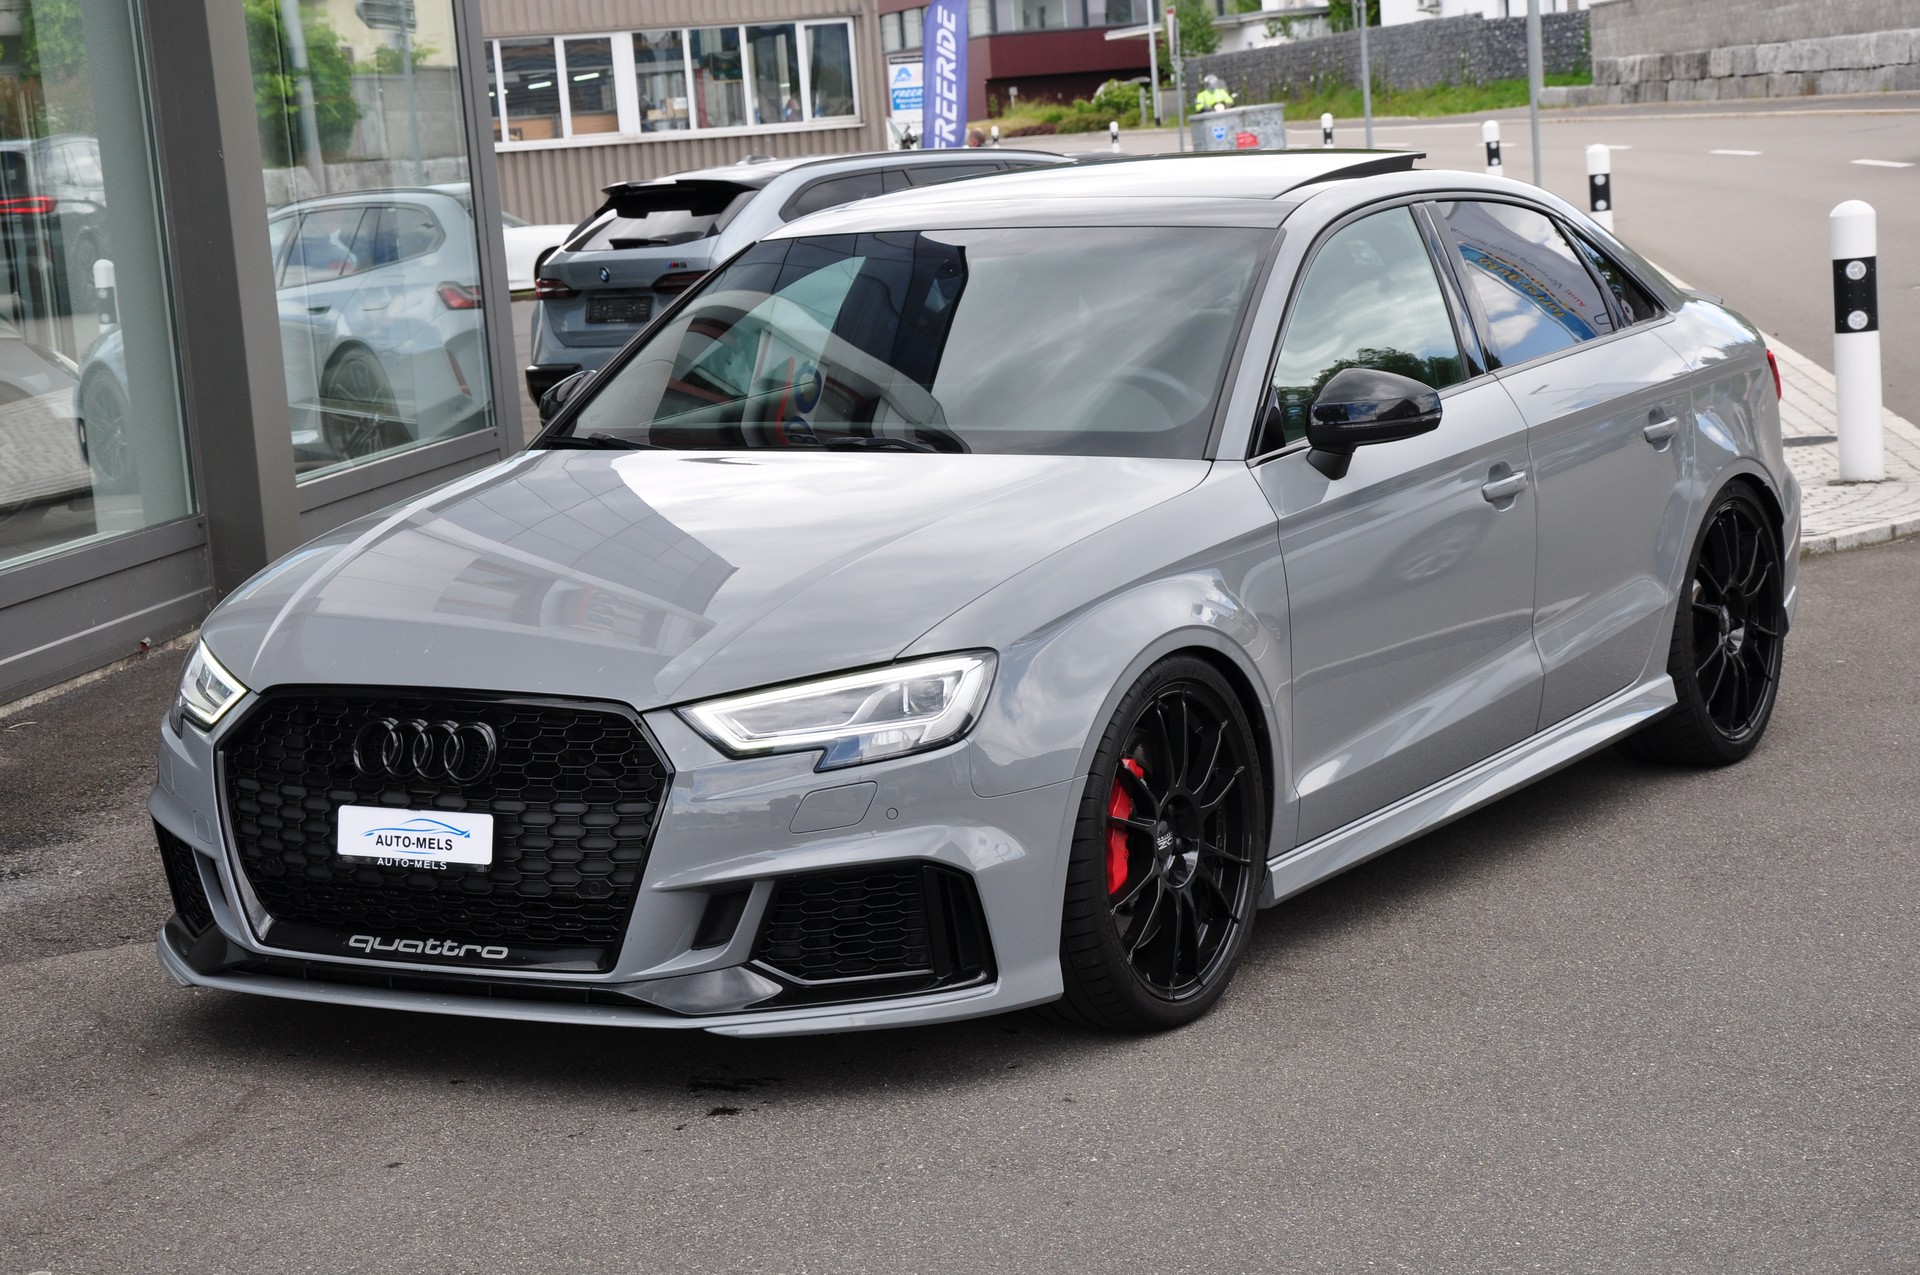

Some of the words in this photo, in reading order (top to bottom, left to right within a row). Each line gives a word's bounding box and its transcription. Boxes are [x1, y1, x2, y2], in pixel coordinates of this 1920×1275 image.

[1478, 257, 1520, 283] auto
[375, 834, 453, 851] AUTO-MELS
[377, 857, 447, 870] AUTO-MELS
[349, 935, 508, 959] quattro
